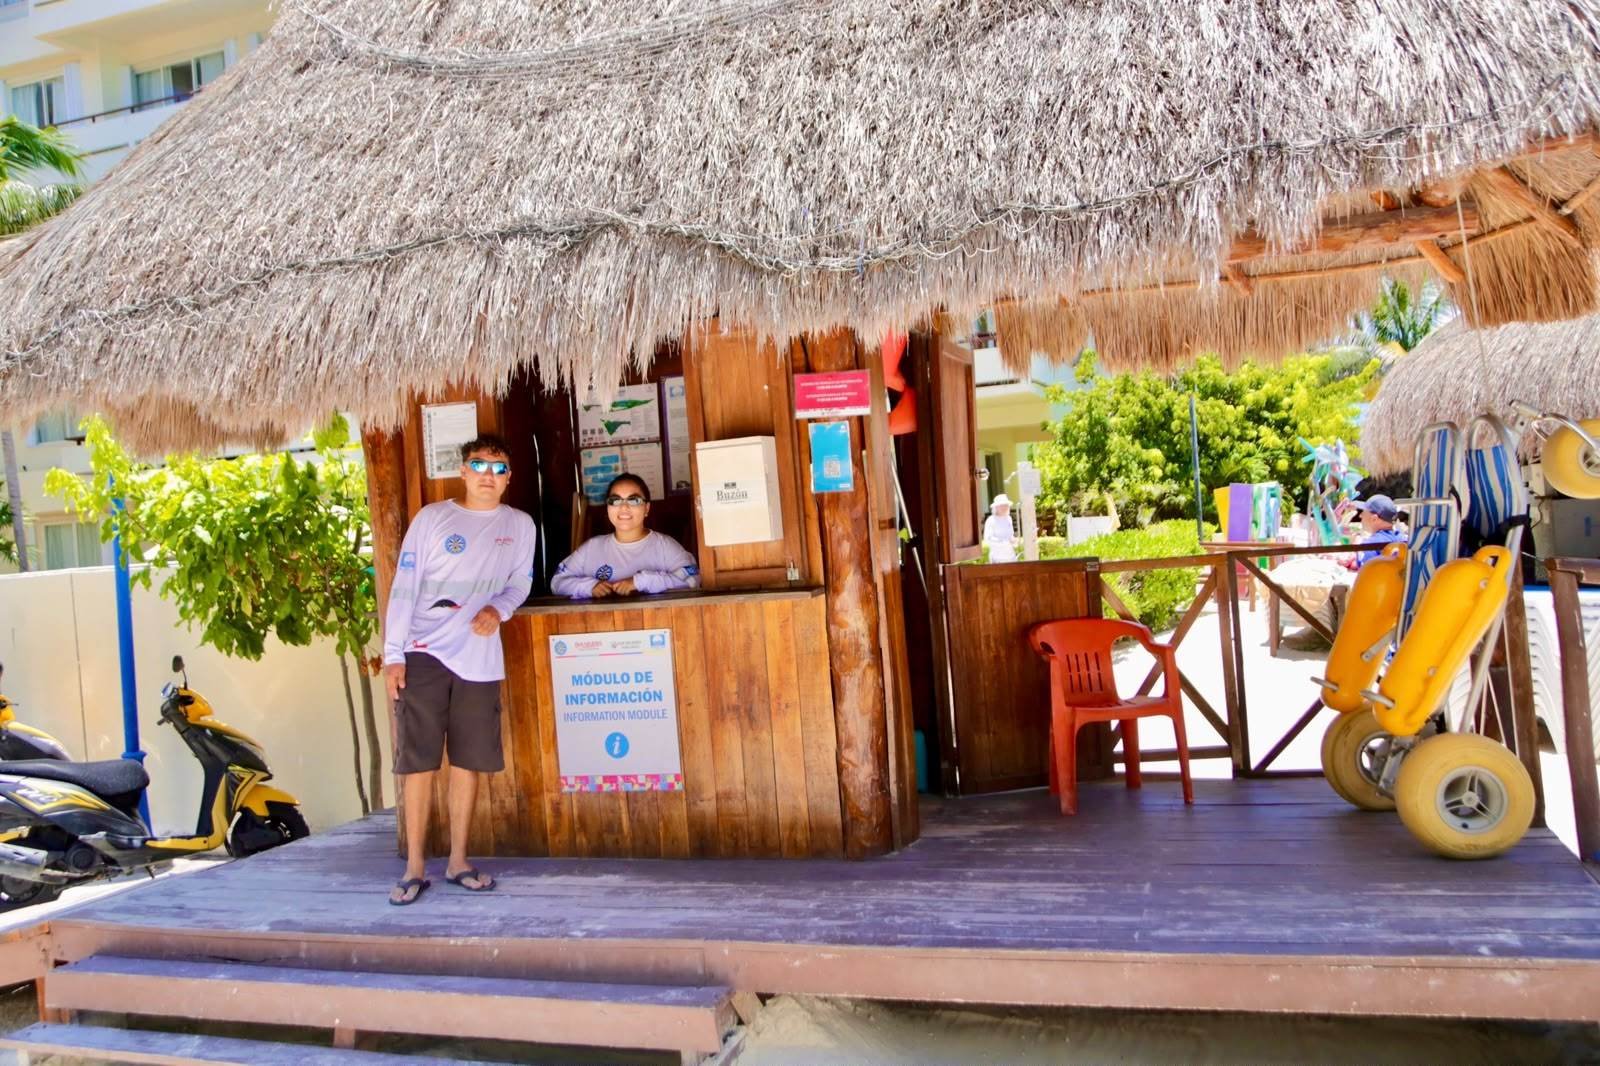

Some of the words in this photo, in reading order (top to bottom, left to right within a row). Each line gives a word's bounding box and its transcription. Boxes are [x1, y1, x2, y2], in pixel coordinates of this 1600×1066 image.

[716, 488, 748, 501] Buzón
[571, 671, 631, 686] MÓDULO
[634, 671, 654, 683] DE
[565, 688, 663, 706] INFORMACIÓN
[563, 711, 626, 722] INFORMATION
[627, 708, 668, 720] MODULE
